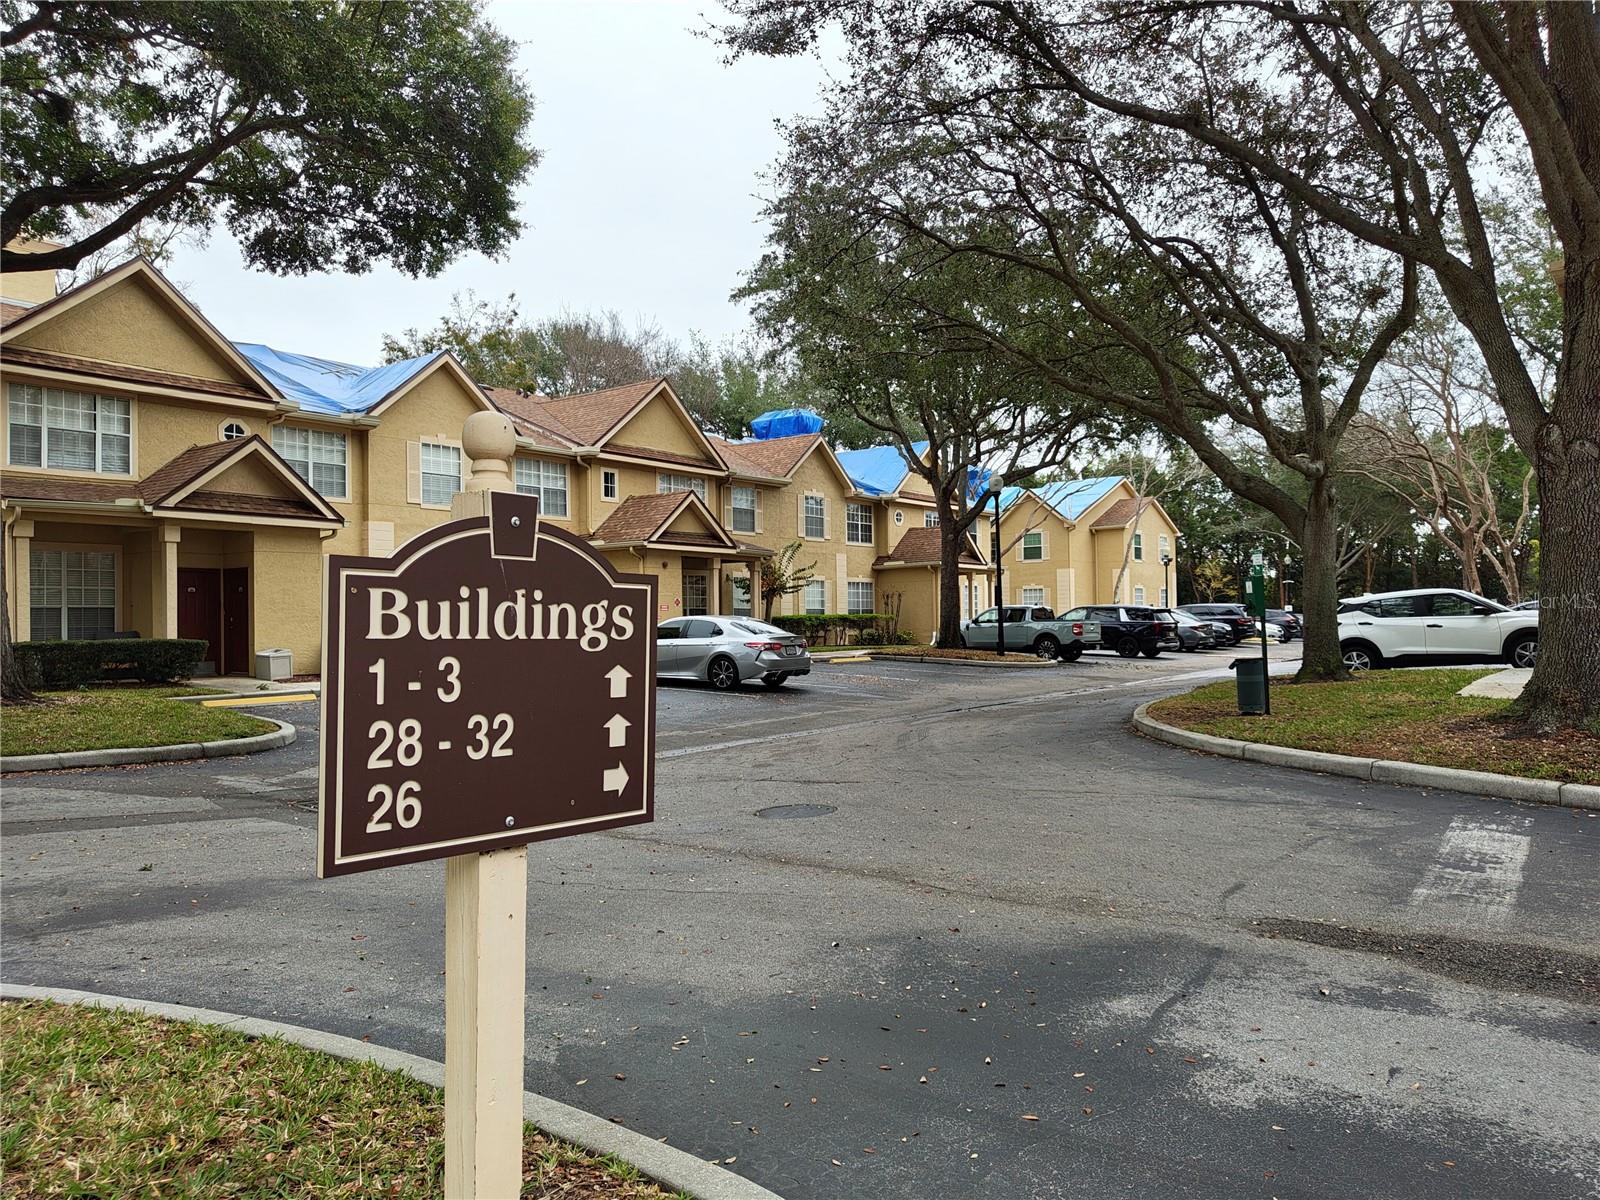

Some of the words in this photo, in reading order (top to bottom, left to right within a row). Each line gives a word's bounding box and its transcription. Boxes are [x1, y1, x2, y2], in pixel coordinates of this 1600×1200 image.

[365, 585, 634, 652] Buildings
[369, 657, 385, 705] 1
[437, 656, 461, 703] 3
[367, 718, 423, 770] 28
[466, 713, 514, 760] 32
[365, 780, 422, 834] 26
